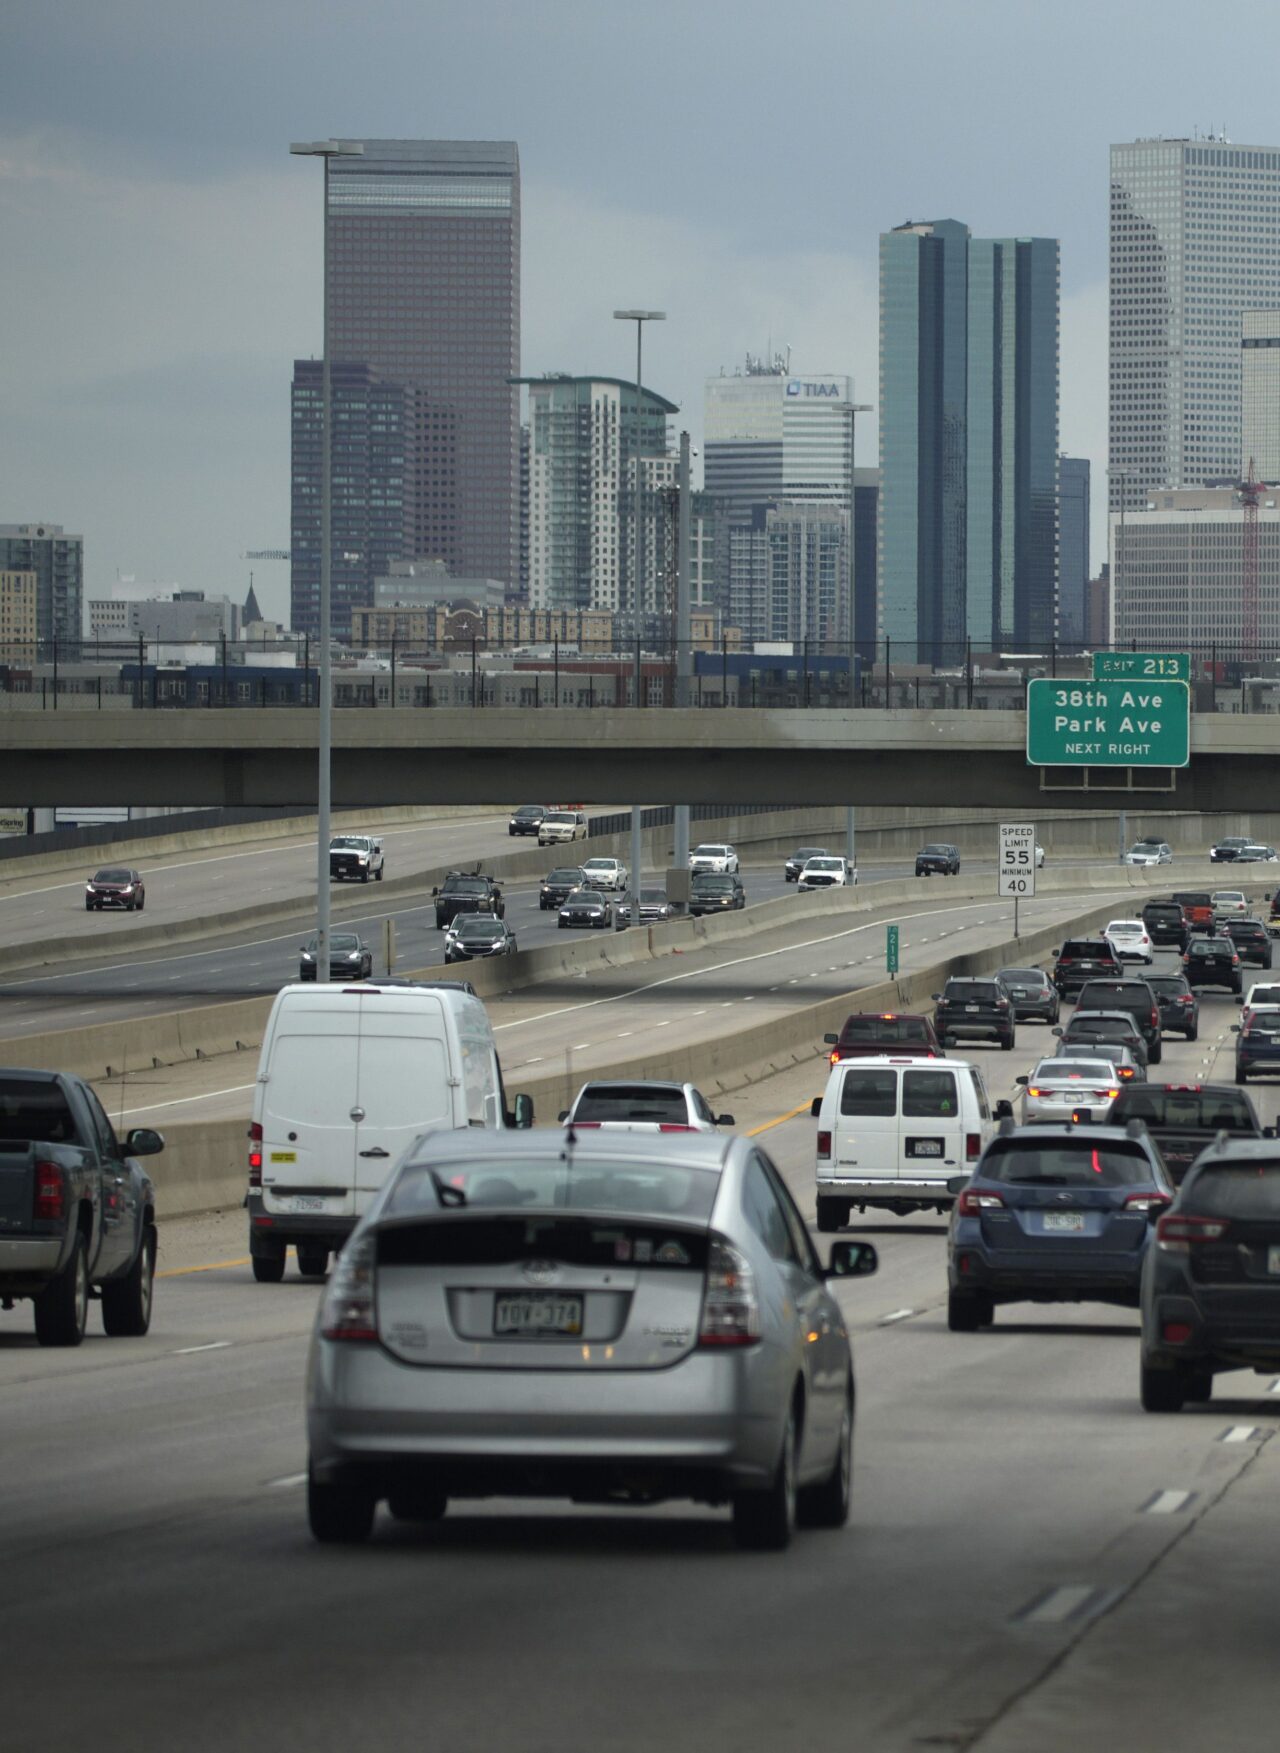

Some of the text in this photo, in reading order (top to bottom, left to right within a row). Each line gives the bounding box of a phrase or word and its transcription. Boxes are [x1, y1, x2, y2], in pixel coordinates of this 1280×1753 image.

[803, 383, 839, 397] TIAA
[1103, 659, 1179, 675] EXIT 213
[1055, 690, 1163, 708] 38th Ave
[1055, 716, 1162, 733] Park Ave
[1065, 743, 1151, 755] NEXT RIGHT
[1001, 828, 1033, 836] SPEED
[1004, 839, 1029, 847] LIMIT
[1005, 850, 1029, 864] 55
[1001, 868, 1032, 876] MINIMUM
[1007, 880, 1027, 892] 40
